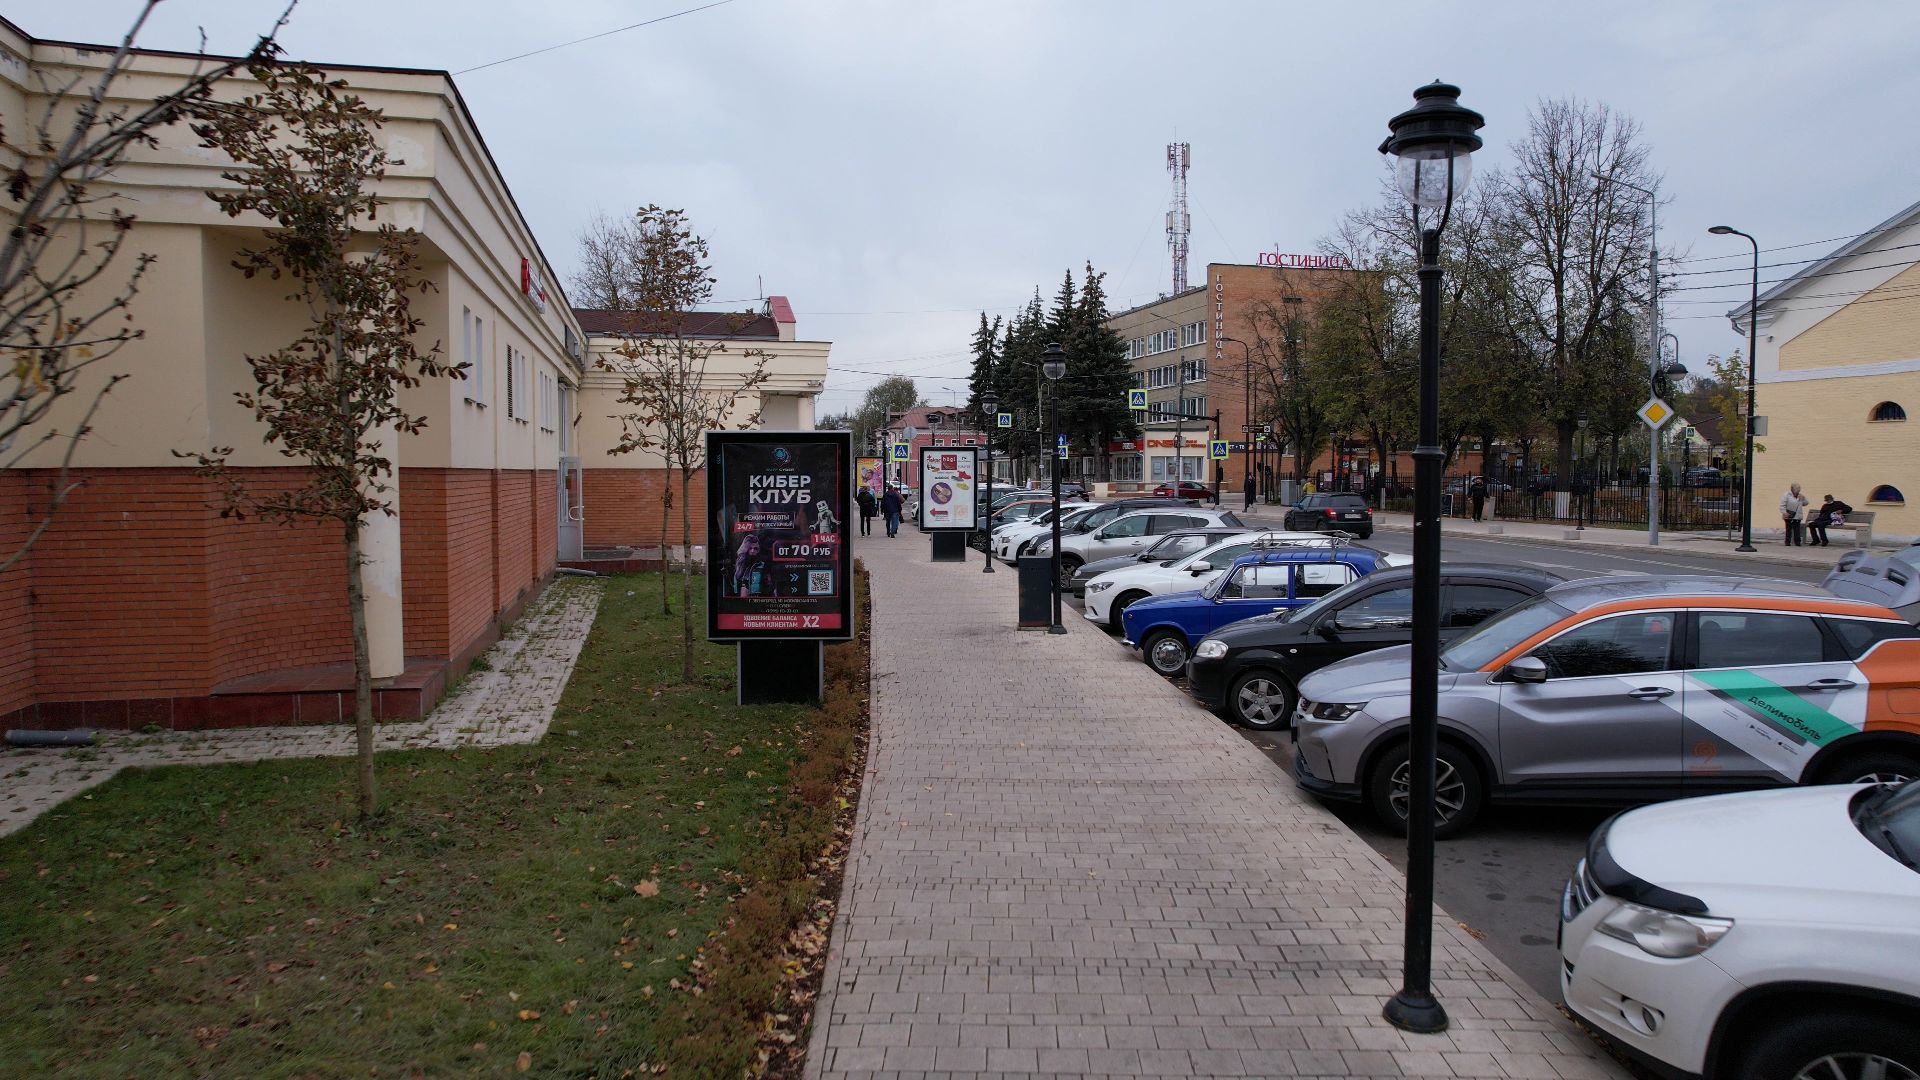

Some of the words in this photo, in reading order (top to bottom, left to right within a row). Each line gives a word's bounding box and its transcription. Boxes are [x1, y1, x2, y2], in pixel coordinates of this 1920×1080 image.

[1258, 252, 1351, 268] ГОСТИНИЦА
[1147, 439, 1174, 448] DNS
[749, 475, 811, 488] КИБЕР
[749, 489, 811, 504] КЛУБ
[737, 523, 753, 531] 24/7
[814, 534, 819, 543] 1
[819, 535, 836, 543] ЧАС
[778, 547, 790, 556] ОТ
[791, 544, 810, 556] 70
[813, 547, 831, 556] РУБ
[1747, 696, 1822, 740] делимобиль
